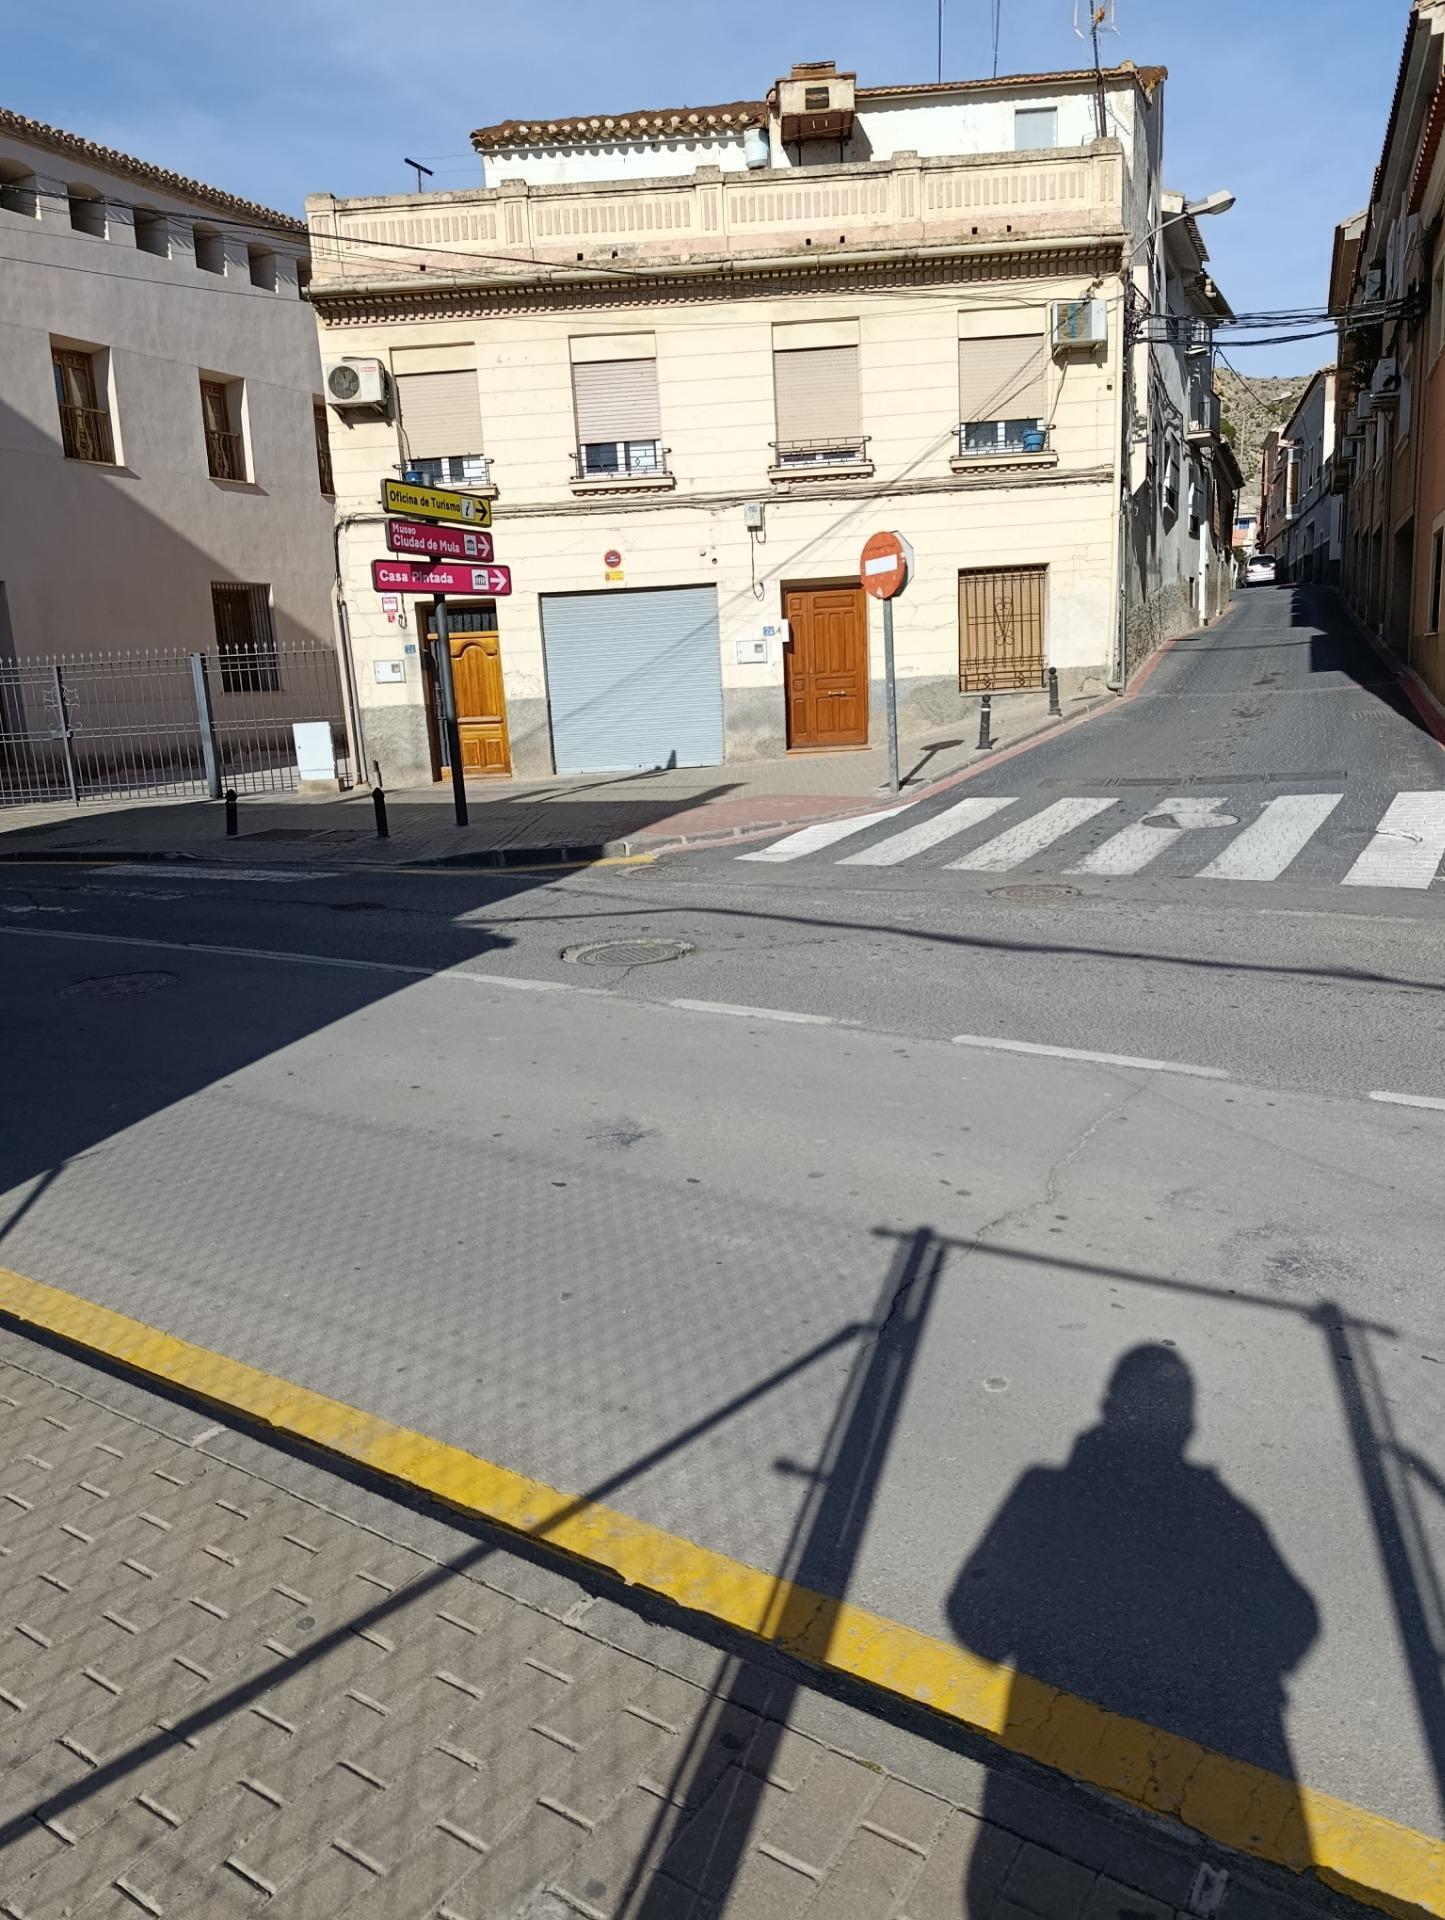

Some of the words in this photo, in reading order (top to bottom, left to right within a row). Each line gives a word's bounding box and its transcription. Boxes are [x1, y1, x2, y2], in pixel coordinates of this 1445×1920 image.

[390, 491, 418, 506] Oficina
[420, 496, 430, 507] de
[431, 498, 460, 512] Turismo
[392, 523, 416, 534] Museo
[394, 534, 425, 549] Ciudad
[427, 538, 437, 550] de
[440, 541, 460, 553] Mula
[379, 569, 409, 582] Casa
[412, 570, 454, 584] Pintada
